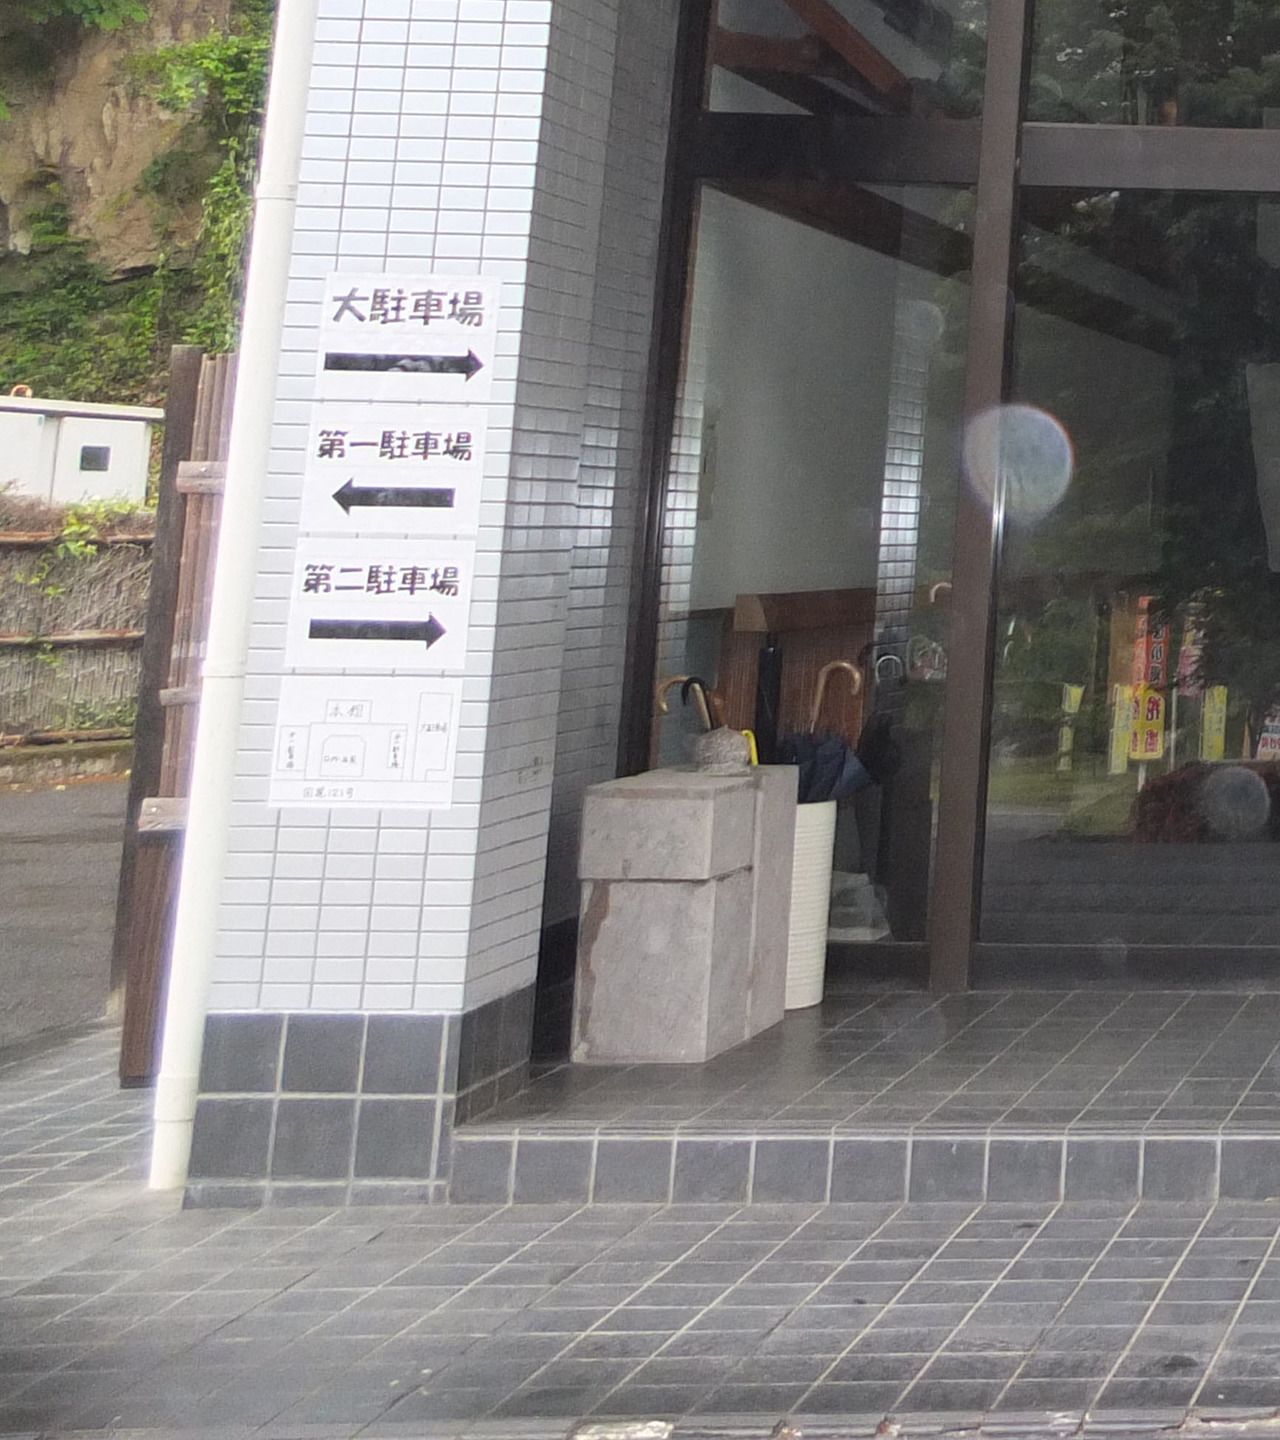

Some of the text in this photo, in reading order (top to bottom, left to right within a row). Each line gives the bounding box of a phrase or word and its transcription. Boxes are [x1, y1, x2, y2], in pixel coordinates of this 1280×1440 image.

[332, 287, 485, 327] 大駐車場
[316, 429, 474, 461] 第一駐車場
[302, 563, 460, 597] 第二駐車場
